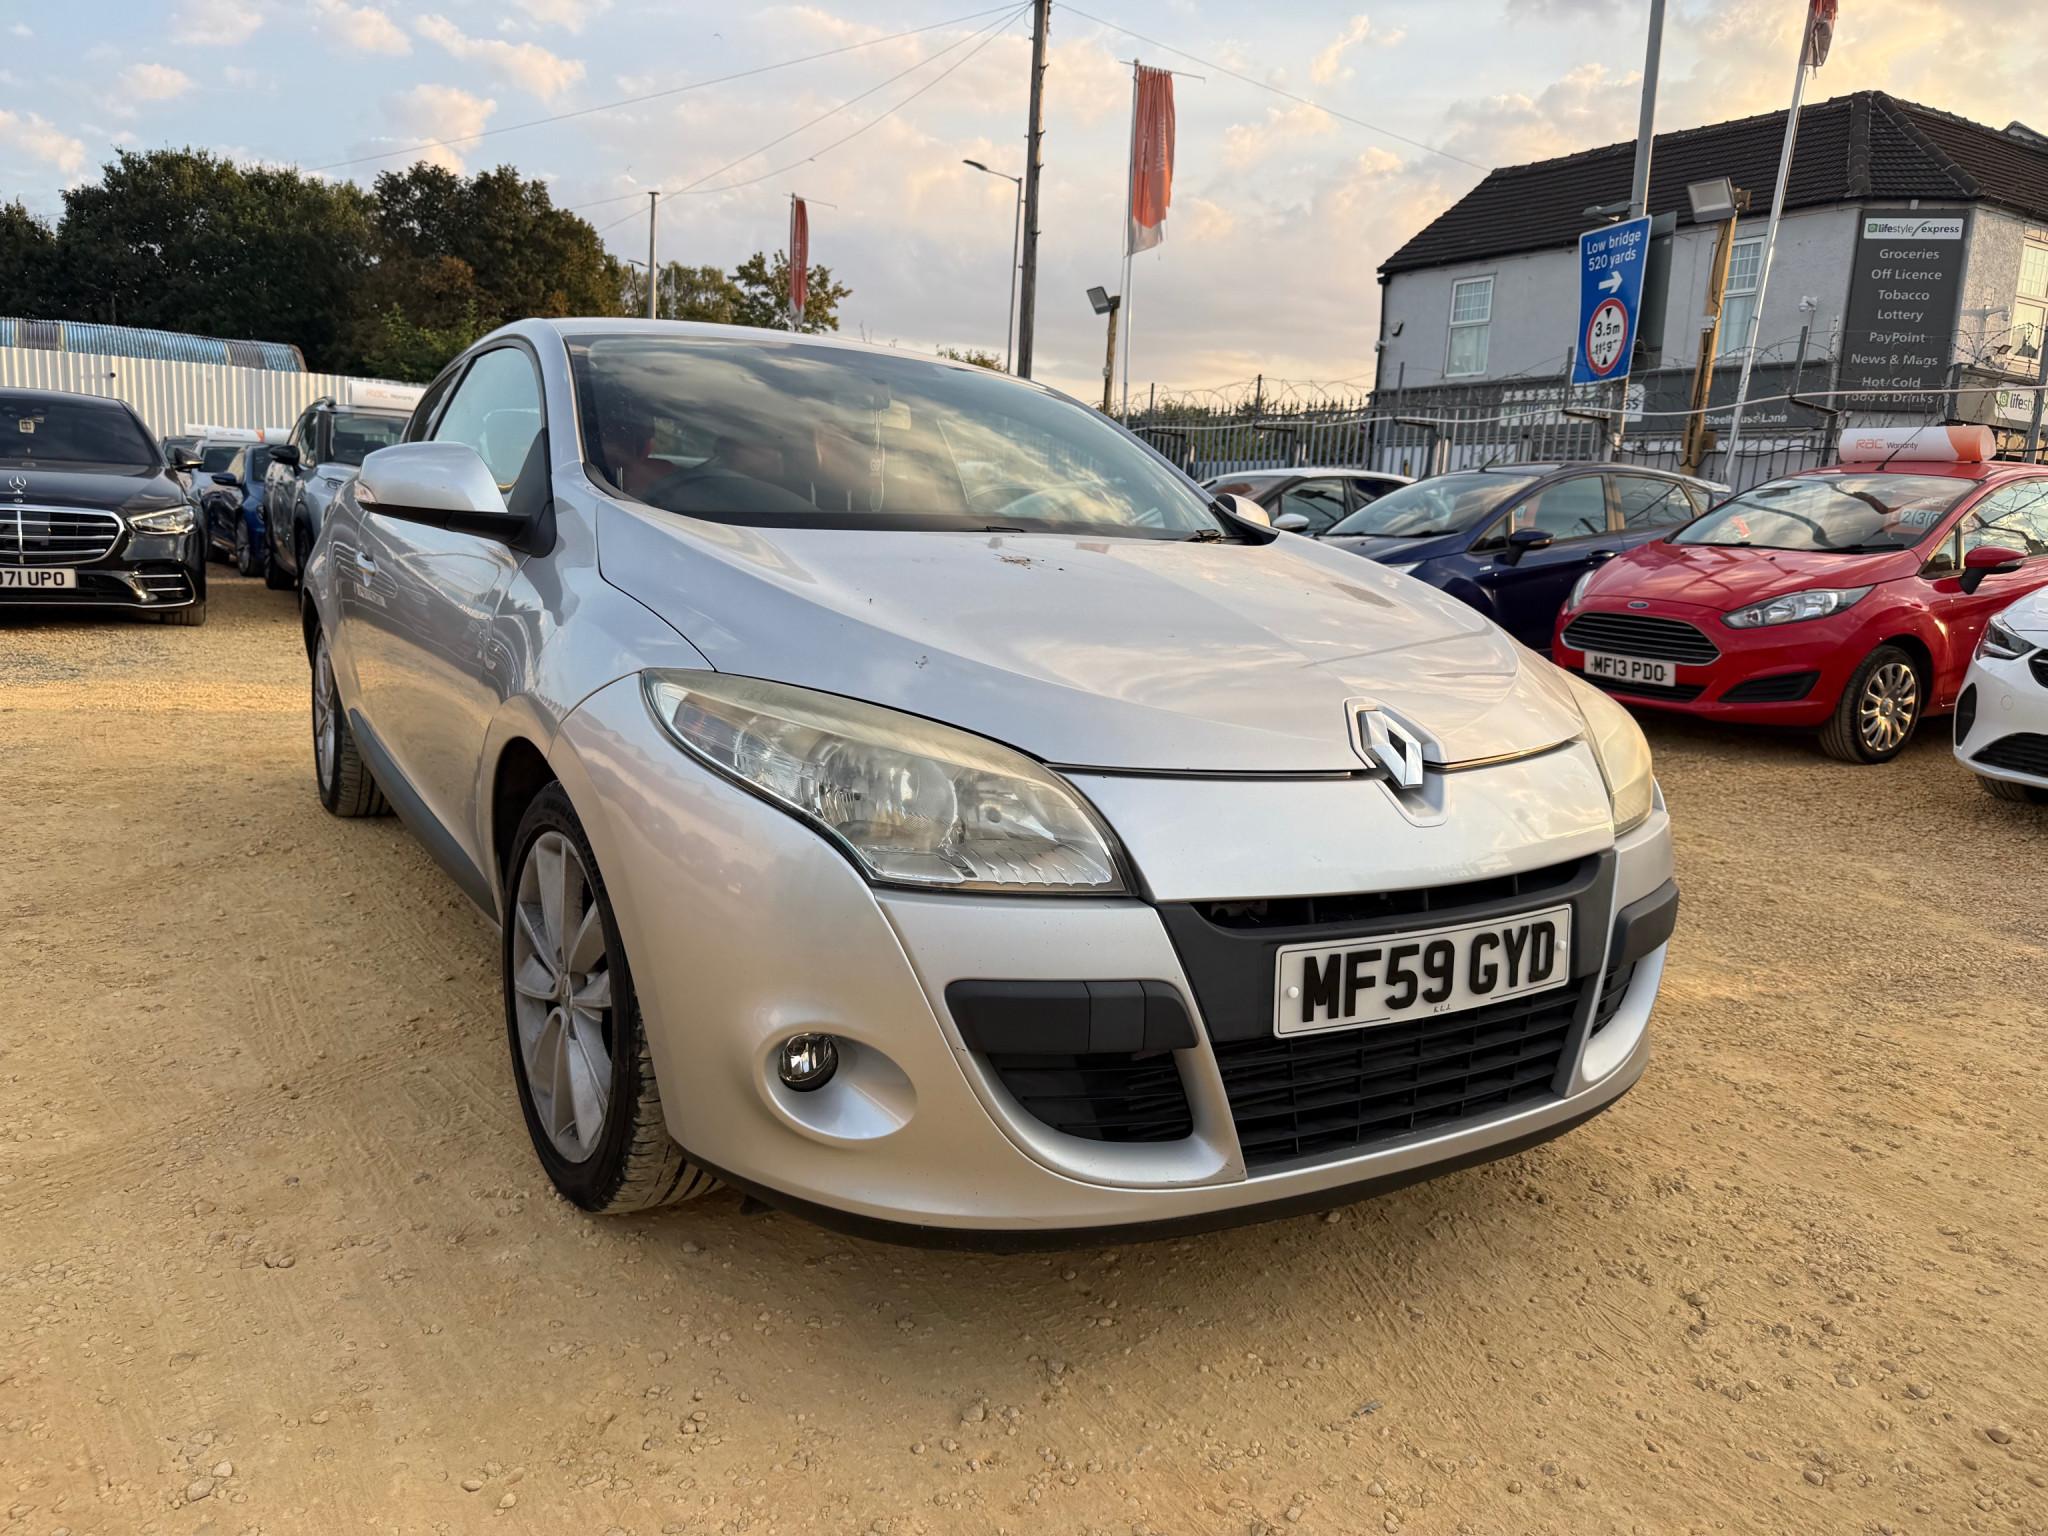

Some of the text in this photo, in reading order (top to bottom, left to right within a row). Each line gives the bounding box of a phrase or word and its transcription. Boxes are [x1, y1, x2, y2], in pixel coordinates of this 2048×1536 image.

[1878, 223, 1960, 235] lifestyle express
[1586, 230, 1642, 255] Low bridge
[1588, 247, 1637, 272] 520 yards
[1879, 248, 1940, 260] Groceries
[1871, 268, 1943, 281] Off Licence
[1878, 289, 1930, 301] Tobacco
[1877, 309, 1924, 323] Lottery
[1869, 331, 1926, 345] PayPoint
[1851, 353, 1938, 368] News & Mags
[1761, 413, 1788, 423] Lane
[1886, 441, 1919, 450] Warranty
[27, 571, 65, 586] UPO
[1593, 656, 1665, 682] MF13 PDO
[1301, 920, 1556, 1023] MF59 GYD
